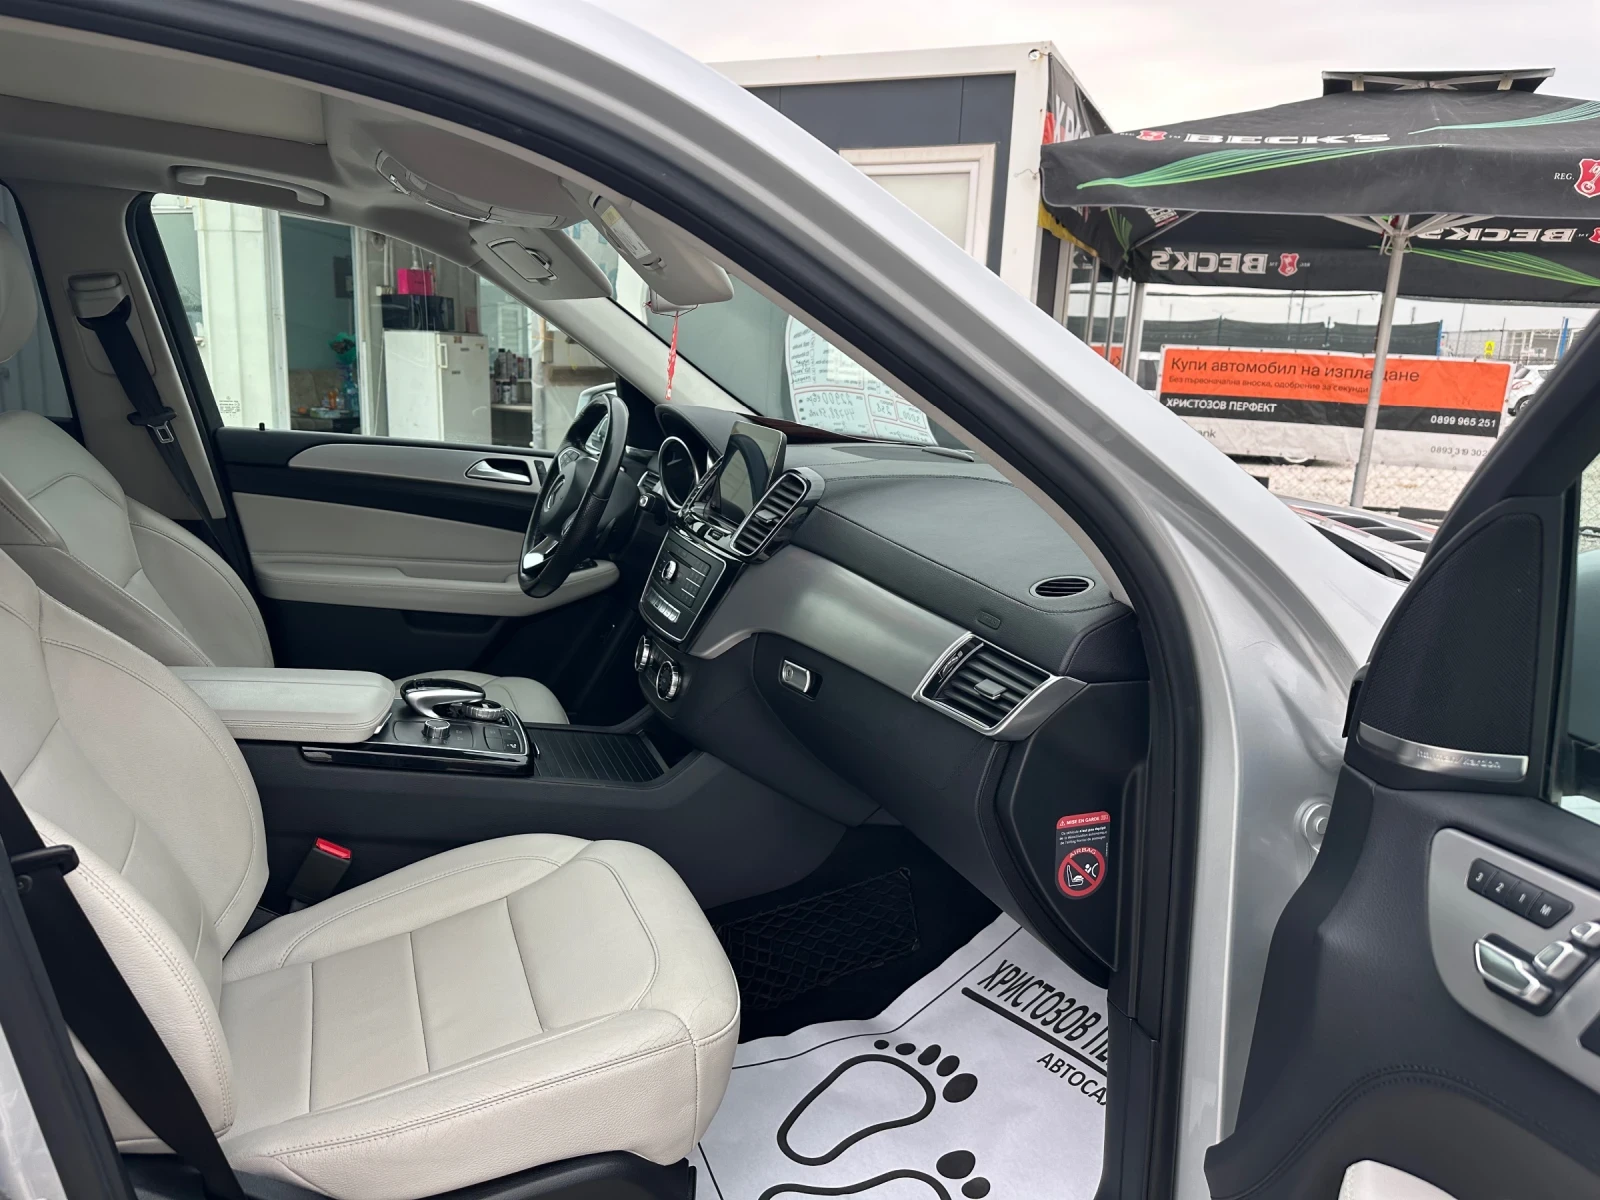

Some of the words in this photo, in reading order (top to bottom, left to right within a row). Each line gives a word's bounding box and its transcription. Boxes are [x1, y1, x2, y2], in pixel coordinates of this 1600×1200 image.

[1183, 133, 1390, 144] BECK'S
[1554, 172, 1574, 181] REG.
[1171, 357, 1207, 373] Купи
[1211, 361, 1297, 375] автомобил
[1301, 365, 1320, 377] на
[1169, 375, 1183, 383] Без
[1184, 377, 1241, 385] първоначална
[1242, 380, 1273, 388] вноска,
[1274, 381, 1320, 390] одобрение
[1333, 385, 1369, 393] секунди
[1166, 398, 1227, 410] ХРИСТОЗОВ
[1228, 401, 1278, 413] ПЕРФЕКТ
[1430, 415, 1456, 425] 0899
[1457, 416, 1477, 426] 965
[1477, 418, 1496, 428] 251
[1430, 446, 1453, 455] 0893
[1455, 447, 1469, 456] 319
[1070, 847, 1097, 858] AIRBAG
[1475, 872, 1484, 882] 3
[1495, 882, 1504, 893] 2
[1540, 904, 1552, 916] M
[977, 959, 1102, 1041] ХРИСТОЗОВ
[1036, 1052, 1107, 1105] АВТОСА
